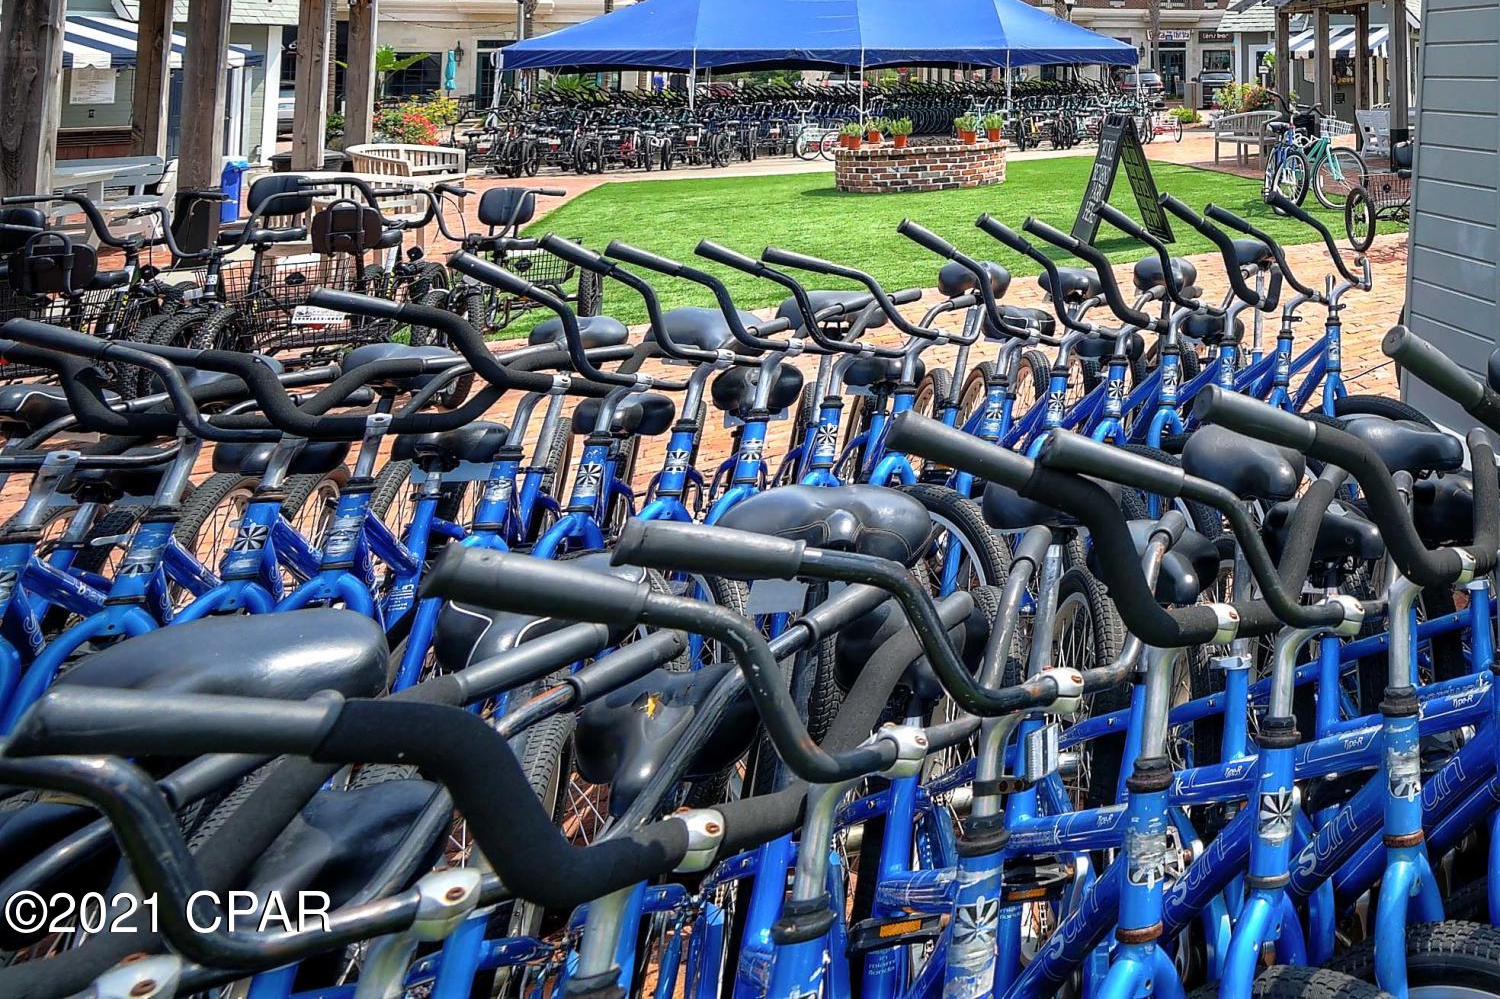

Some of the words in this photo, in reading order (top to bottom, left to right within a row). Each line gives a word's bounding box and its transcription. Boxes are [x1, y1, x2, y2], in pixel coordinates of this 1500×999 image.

[1452, 693, 1474, 708] Type-R
[1343, 735, 1364, 751] Type-R
[1421, 756, 1467, 813] un
